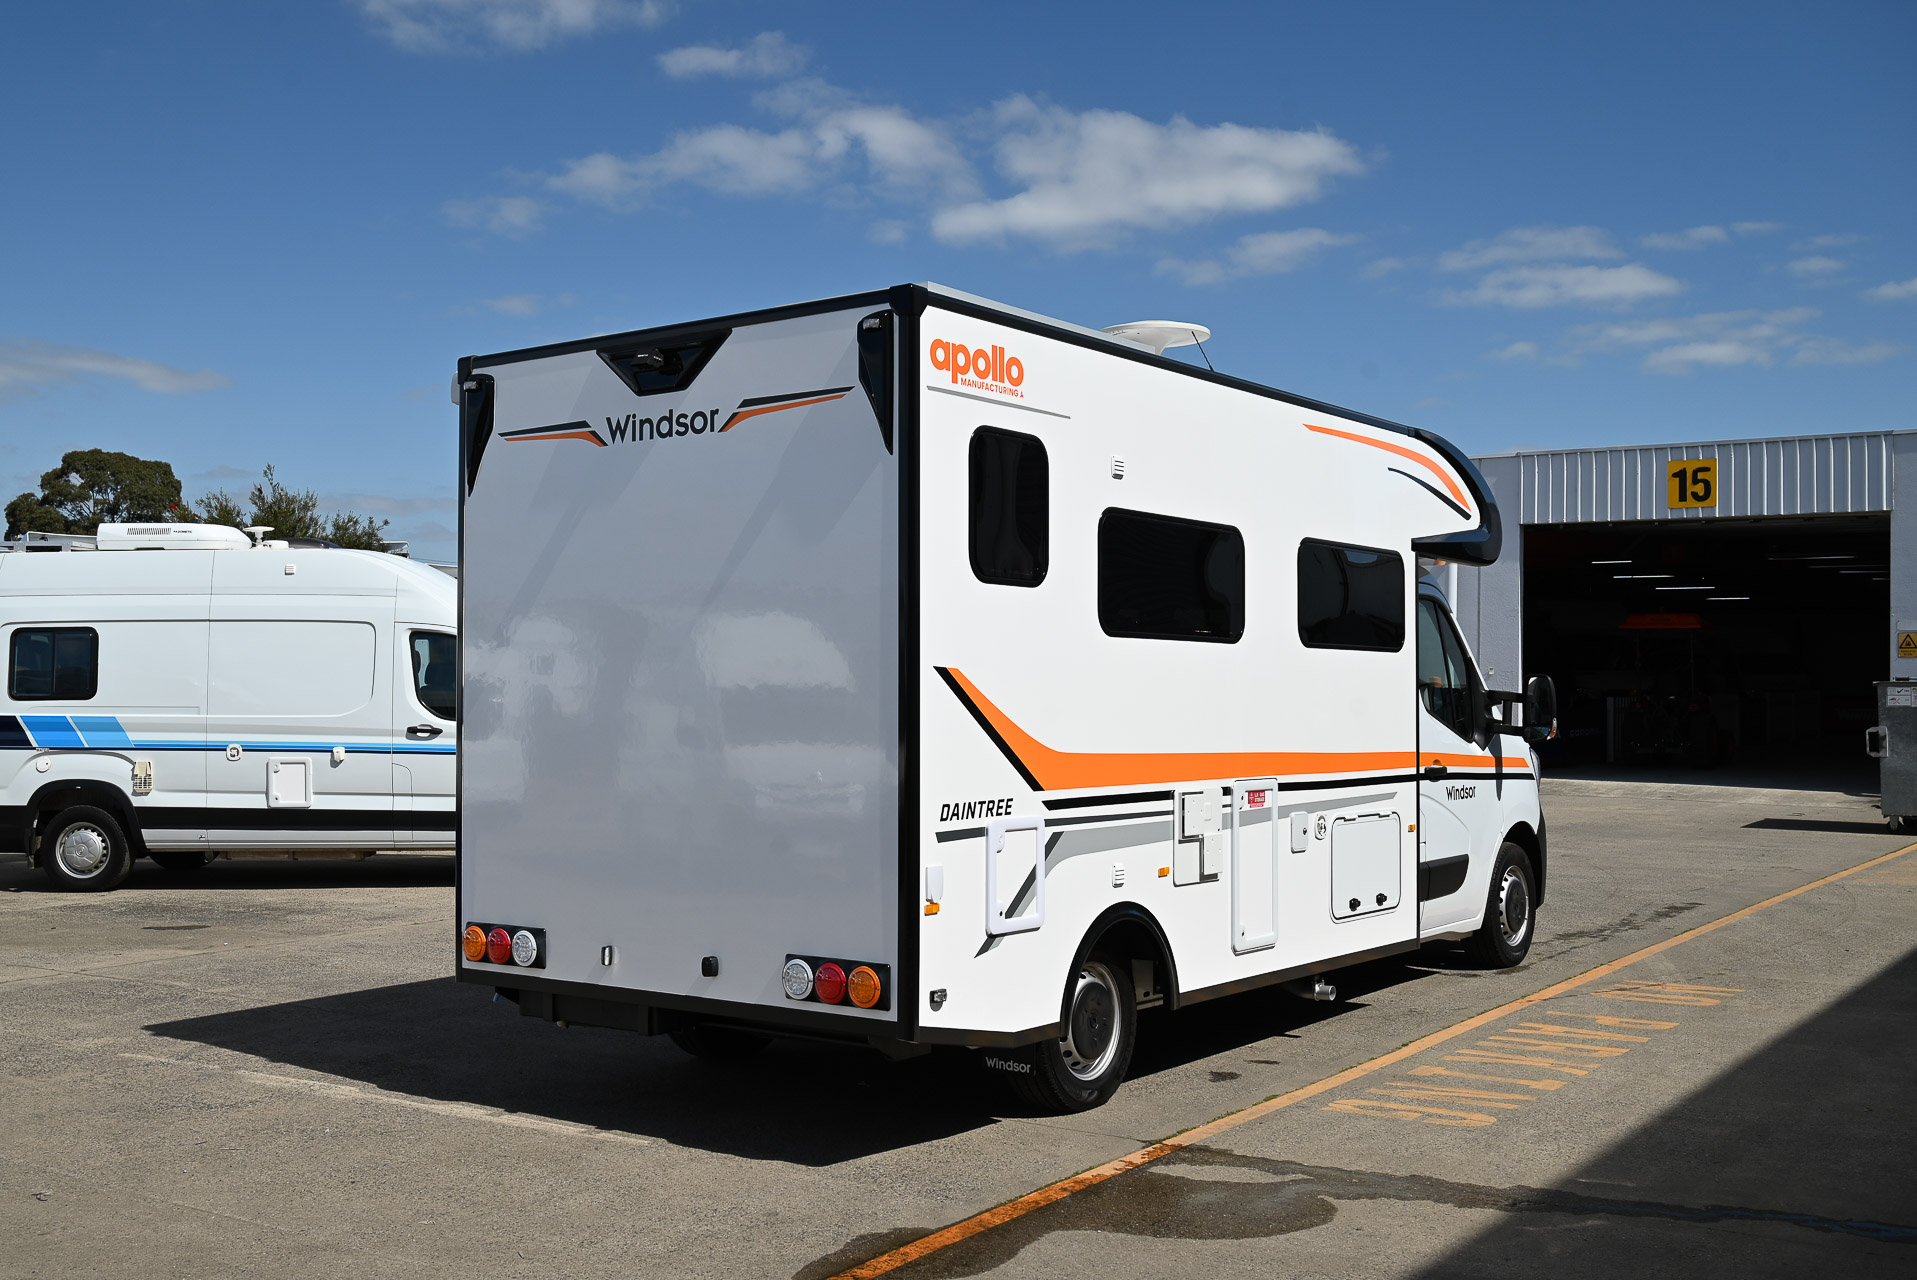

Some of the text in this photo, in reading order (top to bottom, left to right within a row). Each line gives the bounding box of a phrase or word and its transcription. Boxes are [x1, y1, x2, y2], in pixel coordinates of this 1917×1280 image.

[929, 338, 1024, 387] apollo
[960, 377, 1019, 397] MANUFACTURING
[605, 408, 720, 445] Windsor
[1671, 466, 1712, 502] 15
[1445, 784, 1476, 801] Windsor
[939, 797, 1014, 822] DAINTREE
[985, 1056, 1031, 1074] Windsor
[1320, 1010, 1681, 1128] PARKING
